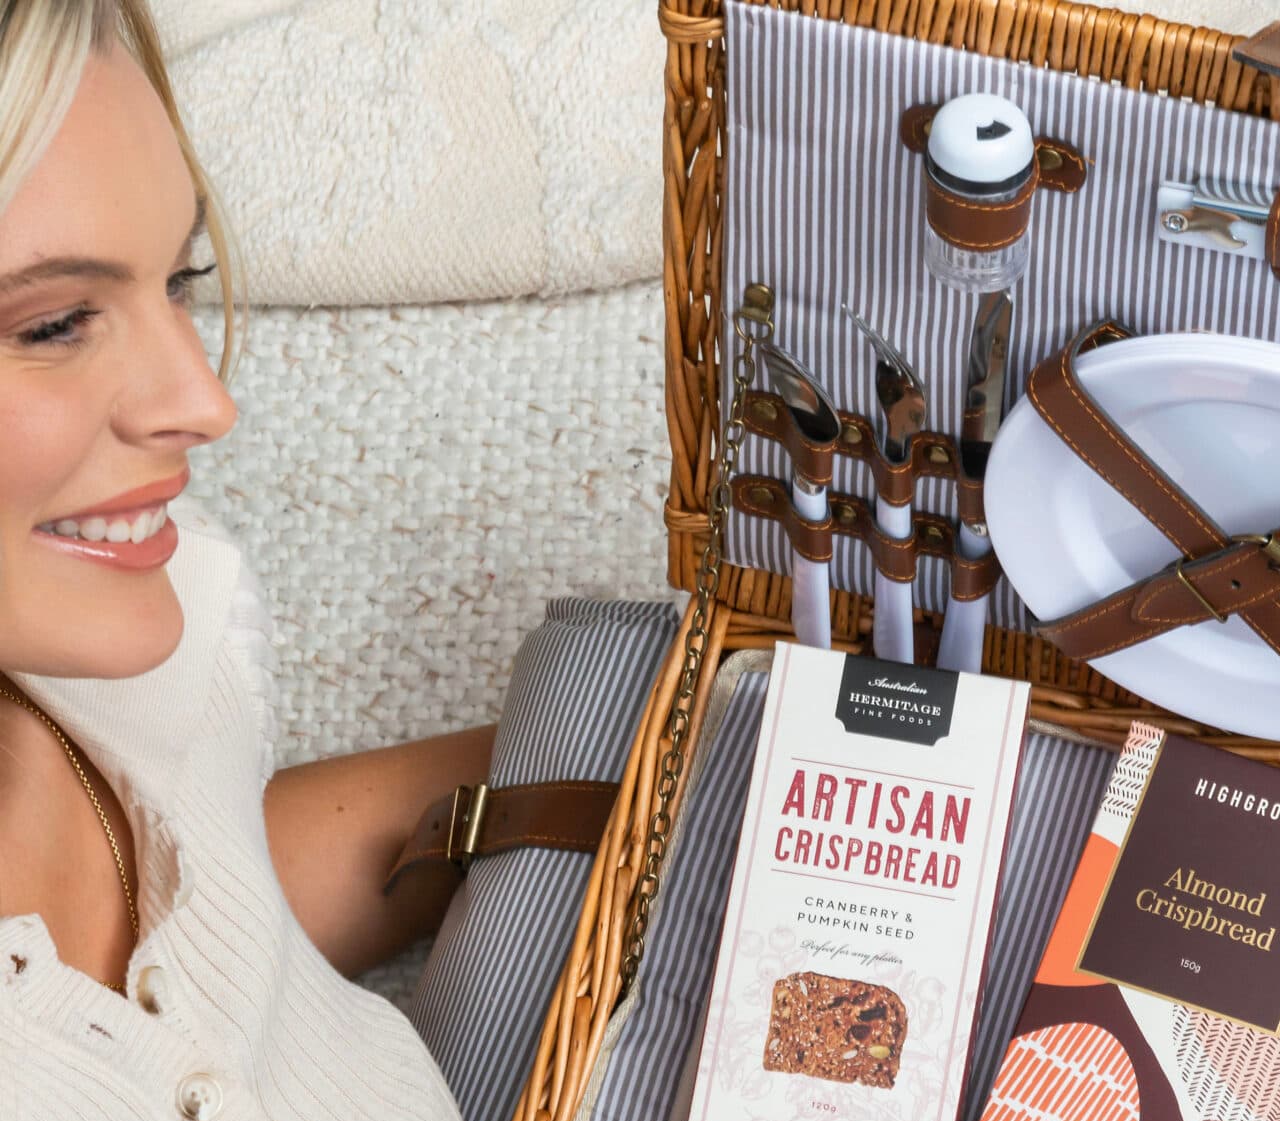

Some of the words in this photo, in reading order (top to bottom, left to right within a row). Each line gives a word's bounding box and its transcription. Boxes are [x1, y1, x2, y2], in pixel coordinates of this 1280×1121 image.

[867, 676, 928, 695] Australian
[849, 692, 941, 717] HERMITAGE
[854, 707, 883, 718] FINE
[891, 713, 932, 726] FOODS
[780, 769, 972, 845] ARTISAN
[774, 826, 962, 890] CRISPBREAD
[1163, 867, 1267, 918] Almond
[804, 896, 899, 920] CRANBERRY
[905, 913, 913, 923] &
[1135, 888, 1276, 952] Crispbread
[797, 912, 869, 932] PUMPKIN
[875, 925, 914, 940] SEED
[1180, 958, 1202, 974] 150g
